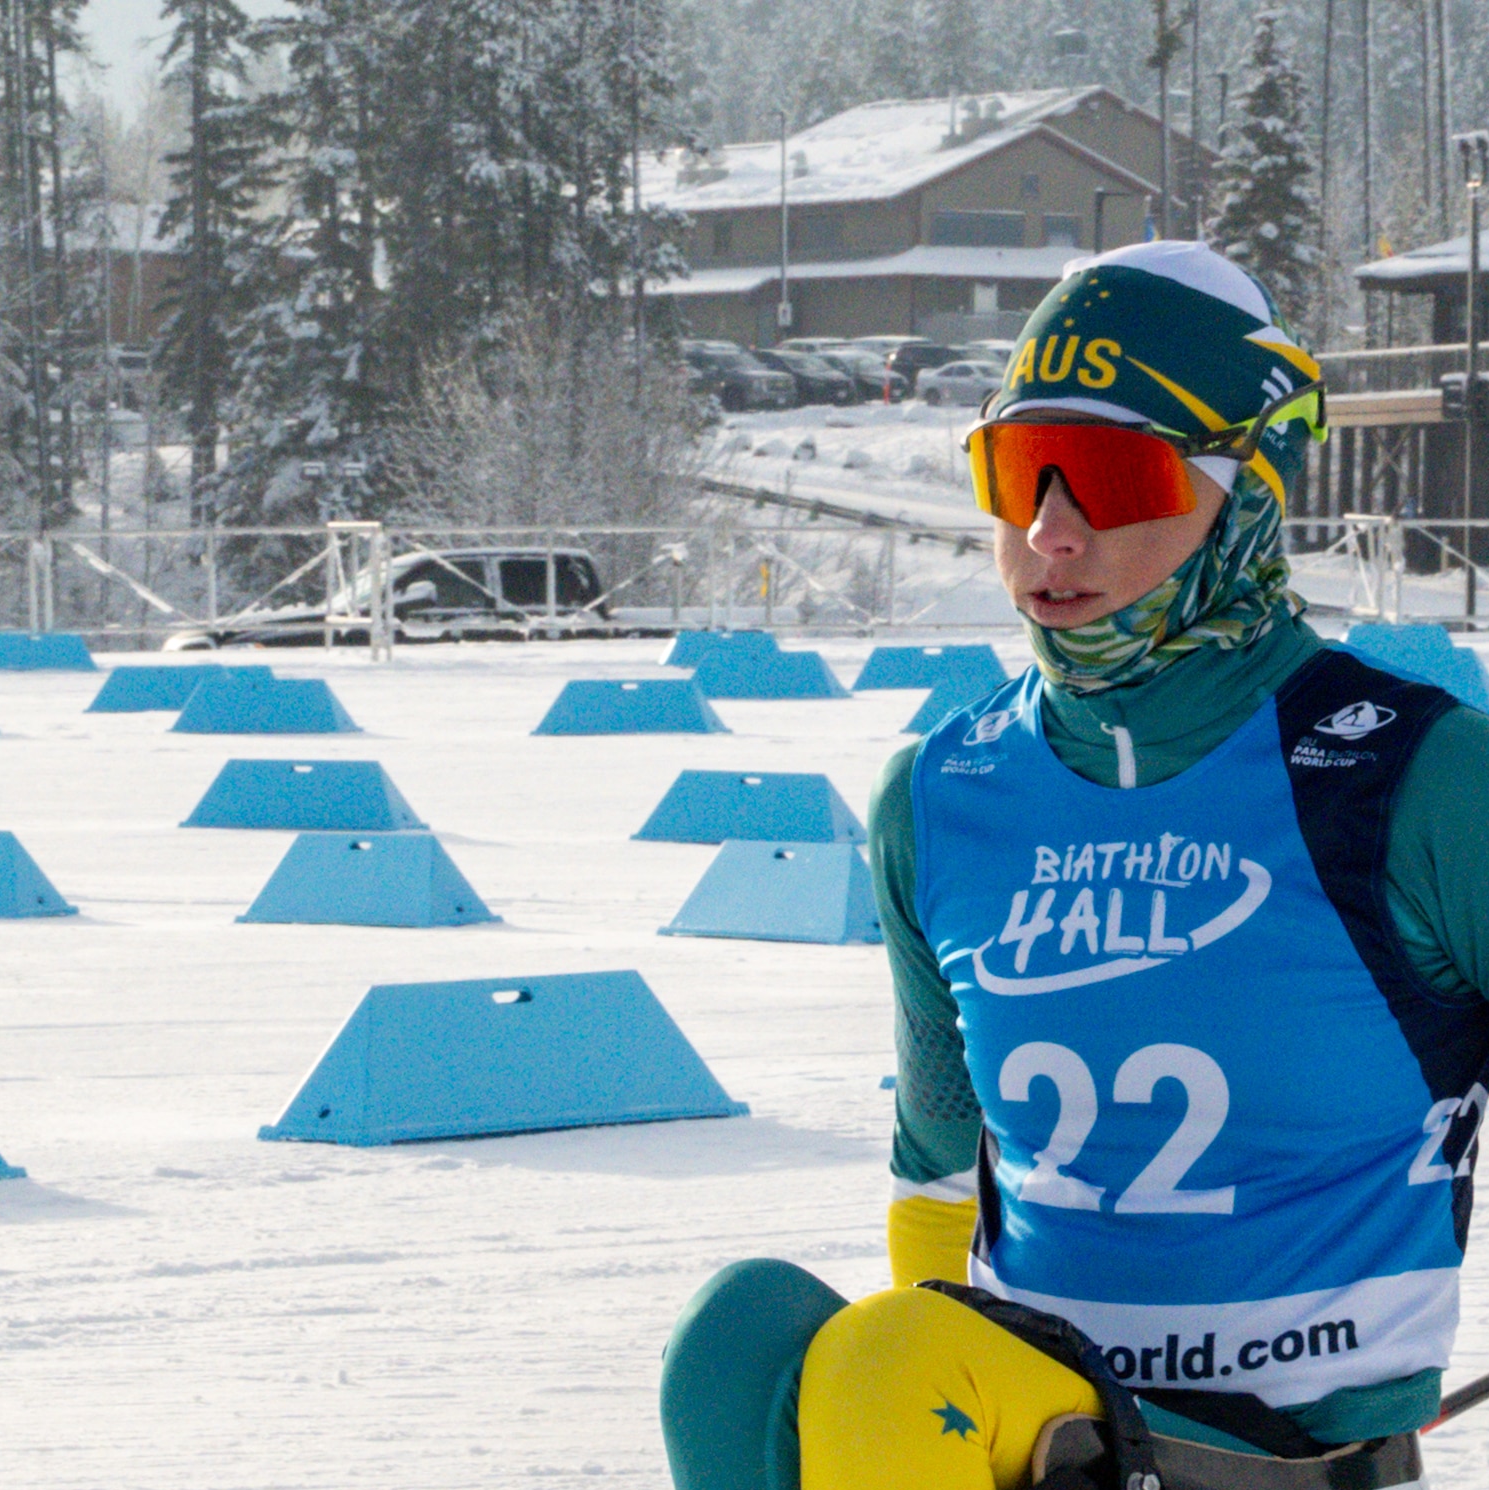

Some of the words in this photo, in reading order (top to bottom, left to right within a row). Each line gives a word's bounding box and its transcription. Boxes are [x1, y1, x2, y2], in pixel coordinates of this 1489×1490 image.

[1008, 334, 1122, 390] AUS
[1290, 755, 1332, 768] WORLD
[1333, 758, 1357, 768] CUP
[1293, 745, 1326, 757] PARA
[998, 887, 1189, 974] 4ALL
[998, 1041, 1235, 1214] 22
[1094, 1318, 1360, 1381] orld.com
